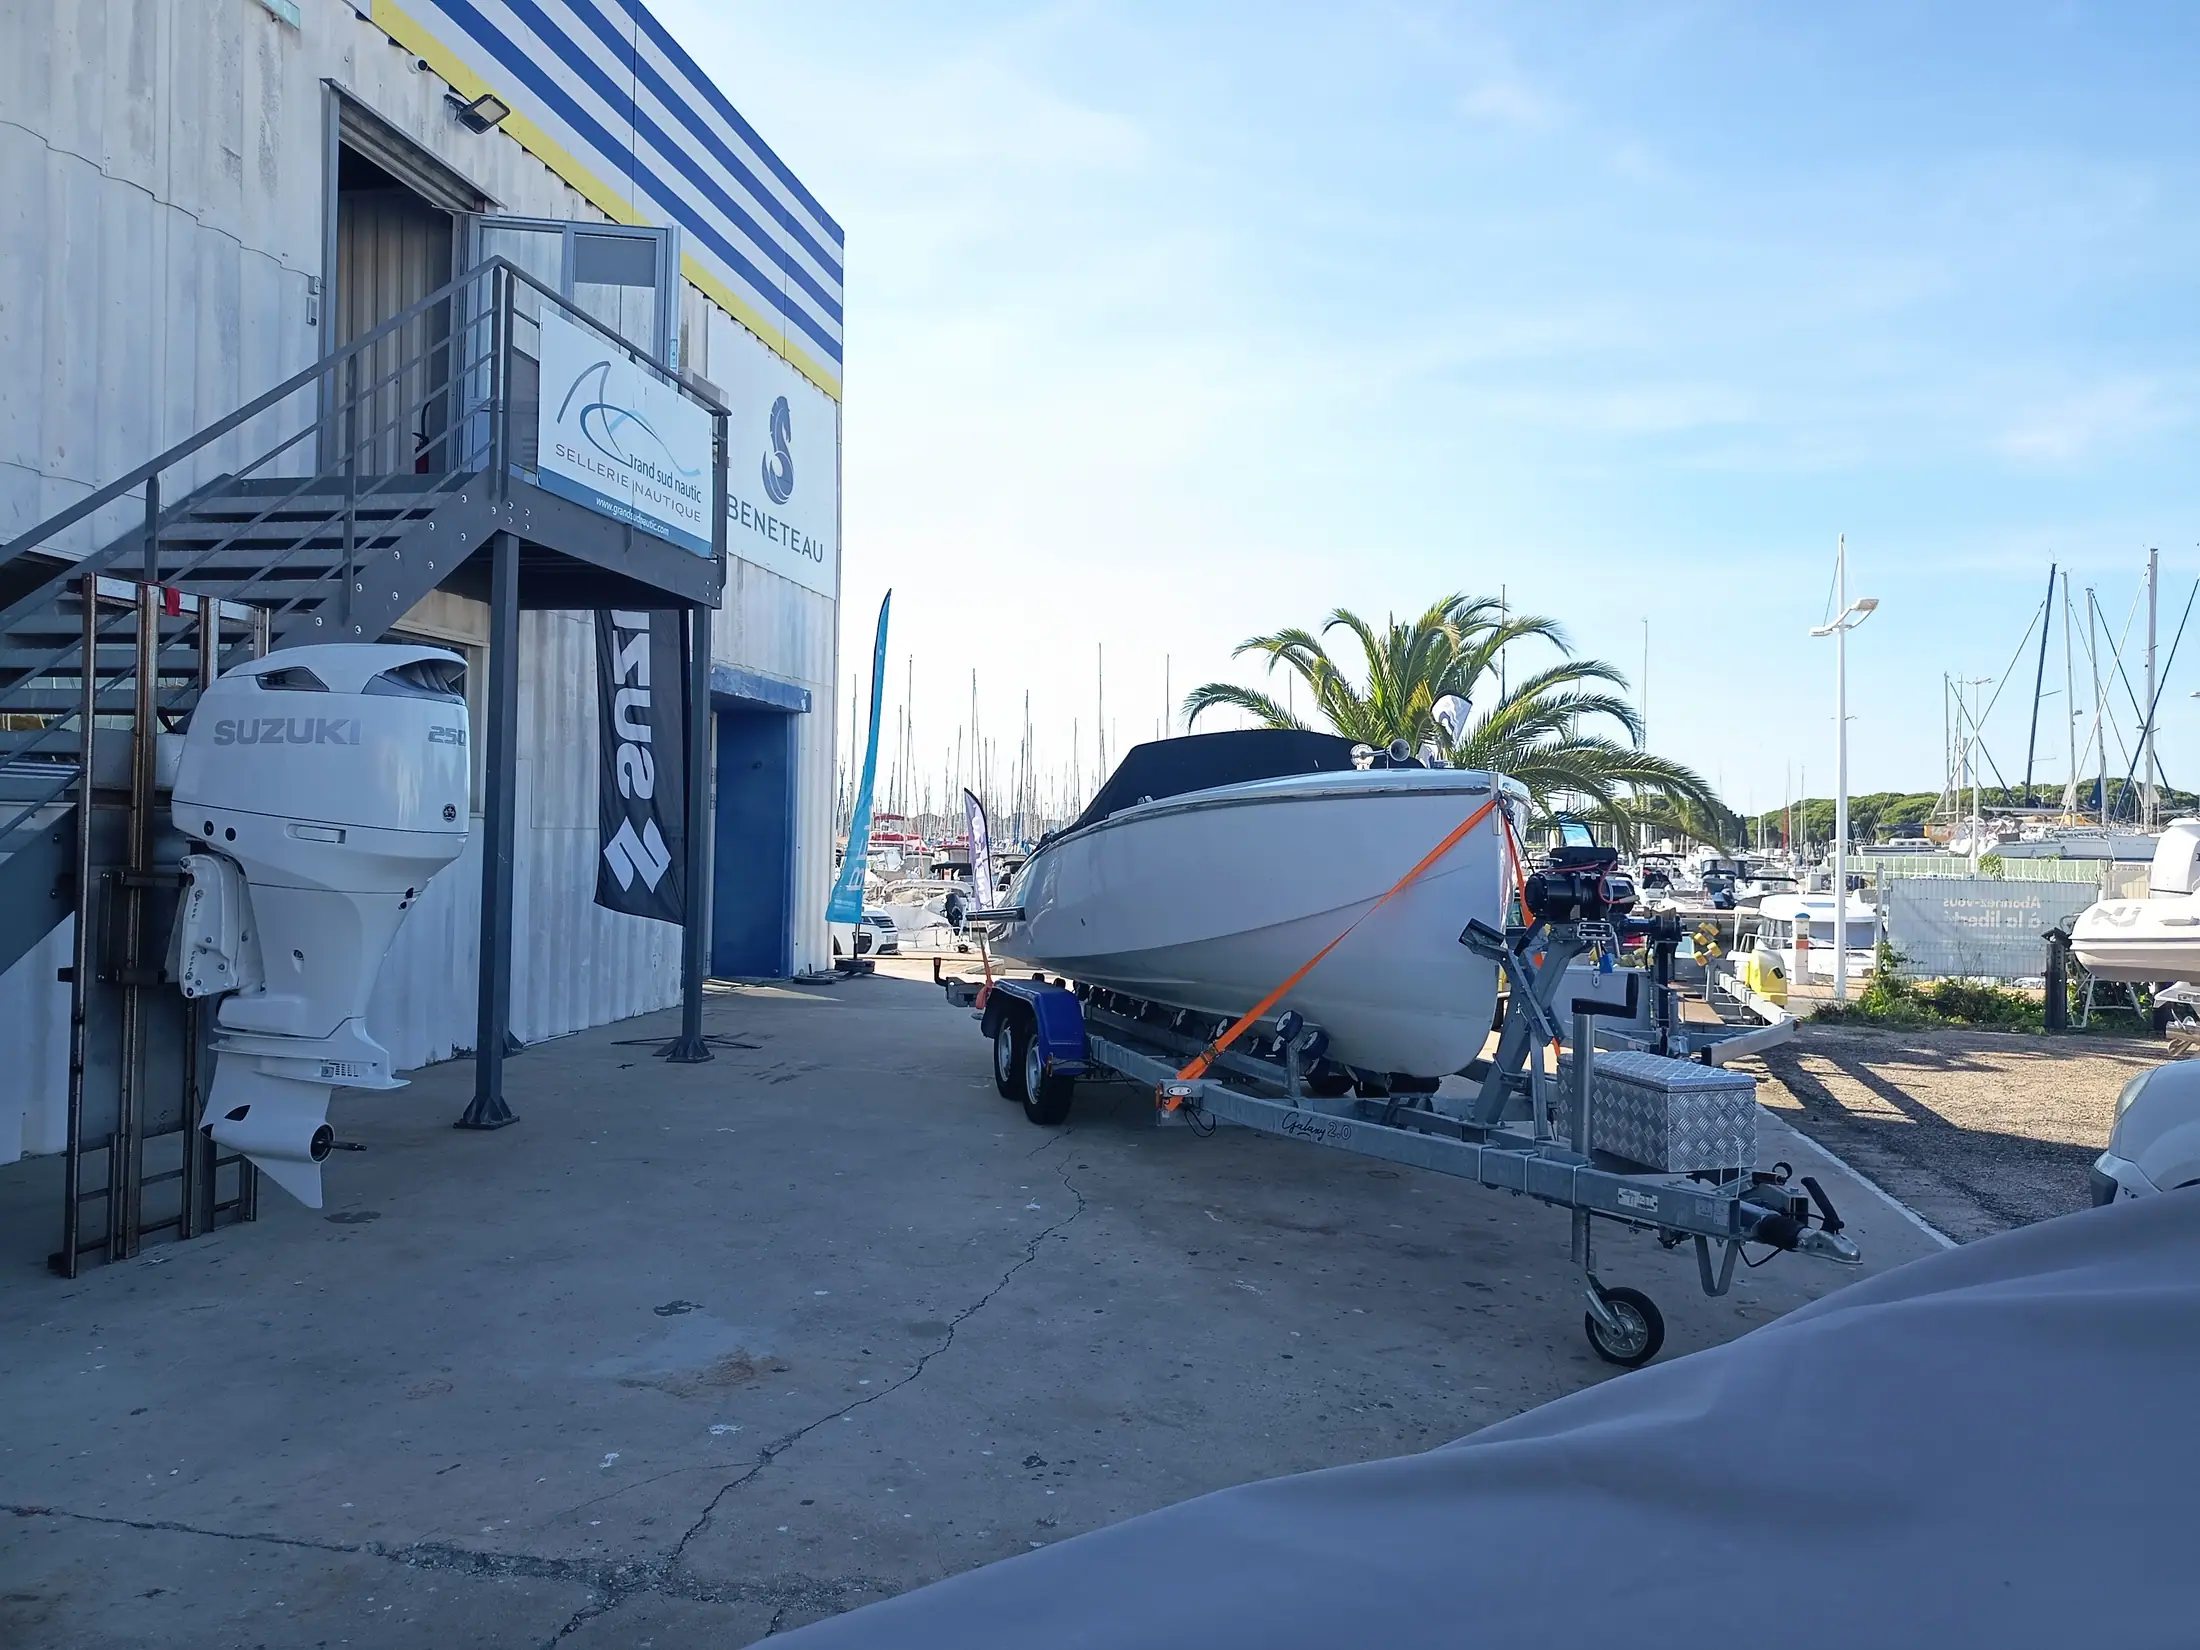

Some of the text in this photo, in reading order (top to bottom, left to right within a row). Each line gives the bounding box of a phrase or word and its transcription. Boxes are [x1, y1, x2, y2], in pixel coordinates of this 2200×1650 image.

[555, 443, 702, 523] SELLERIE NAUTIQUE
[656, 469, 674, 489] sud
[674, 479, 702, 504] nautic
[726, 493, 824, 564] BENETEAU
[213, 717, 362, 746] SUZUKI
[427, 725, 467, 747] 250
[1281, 1111, 1352, 1142] Galaxy 2.0
